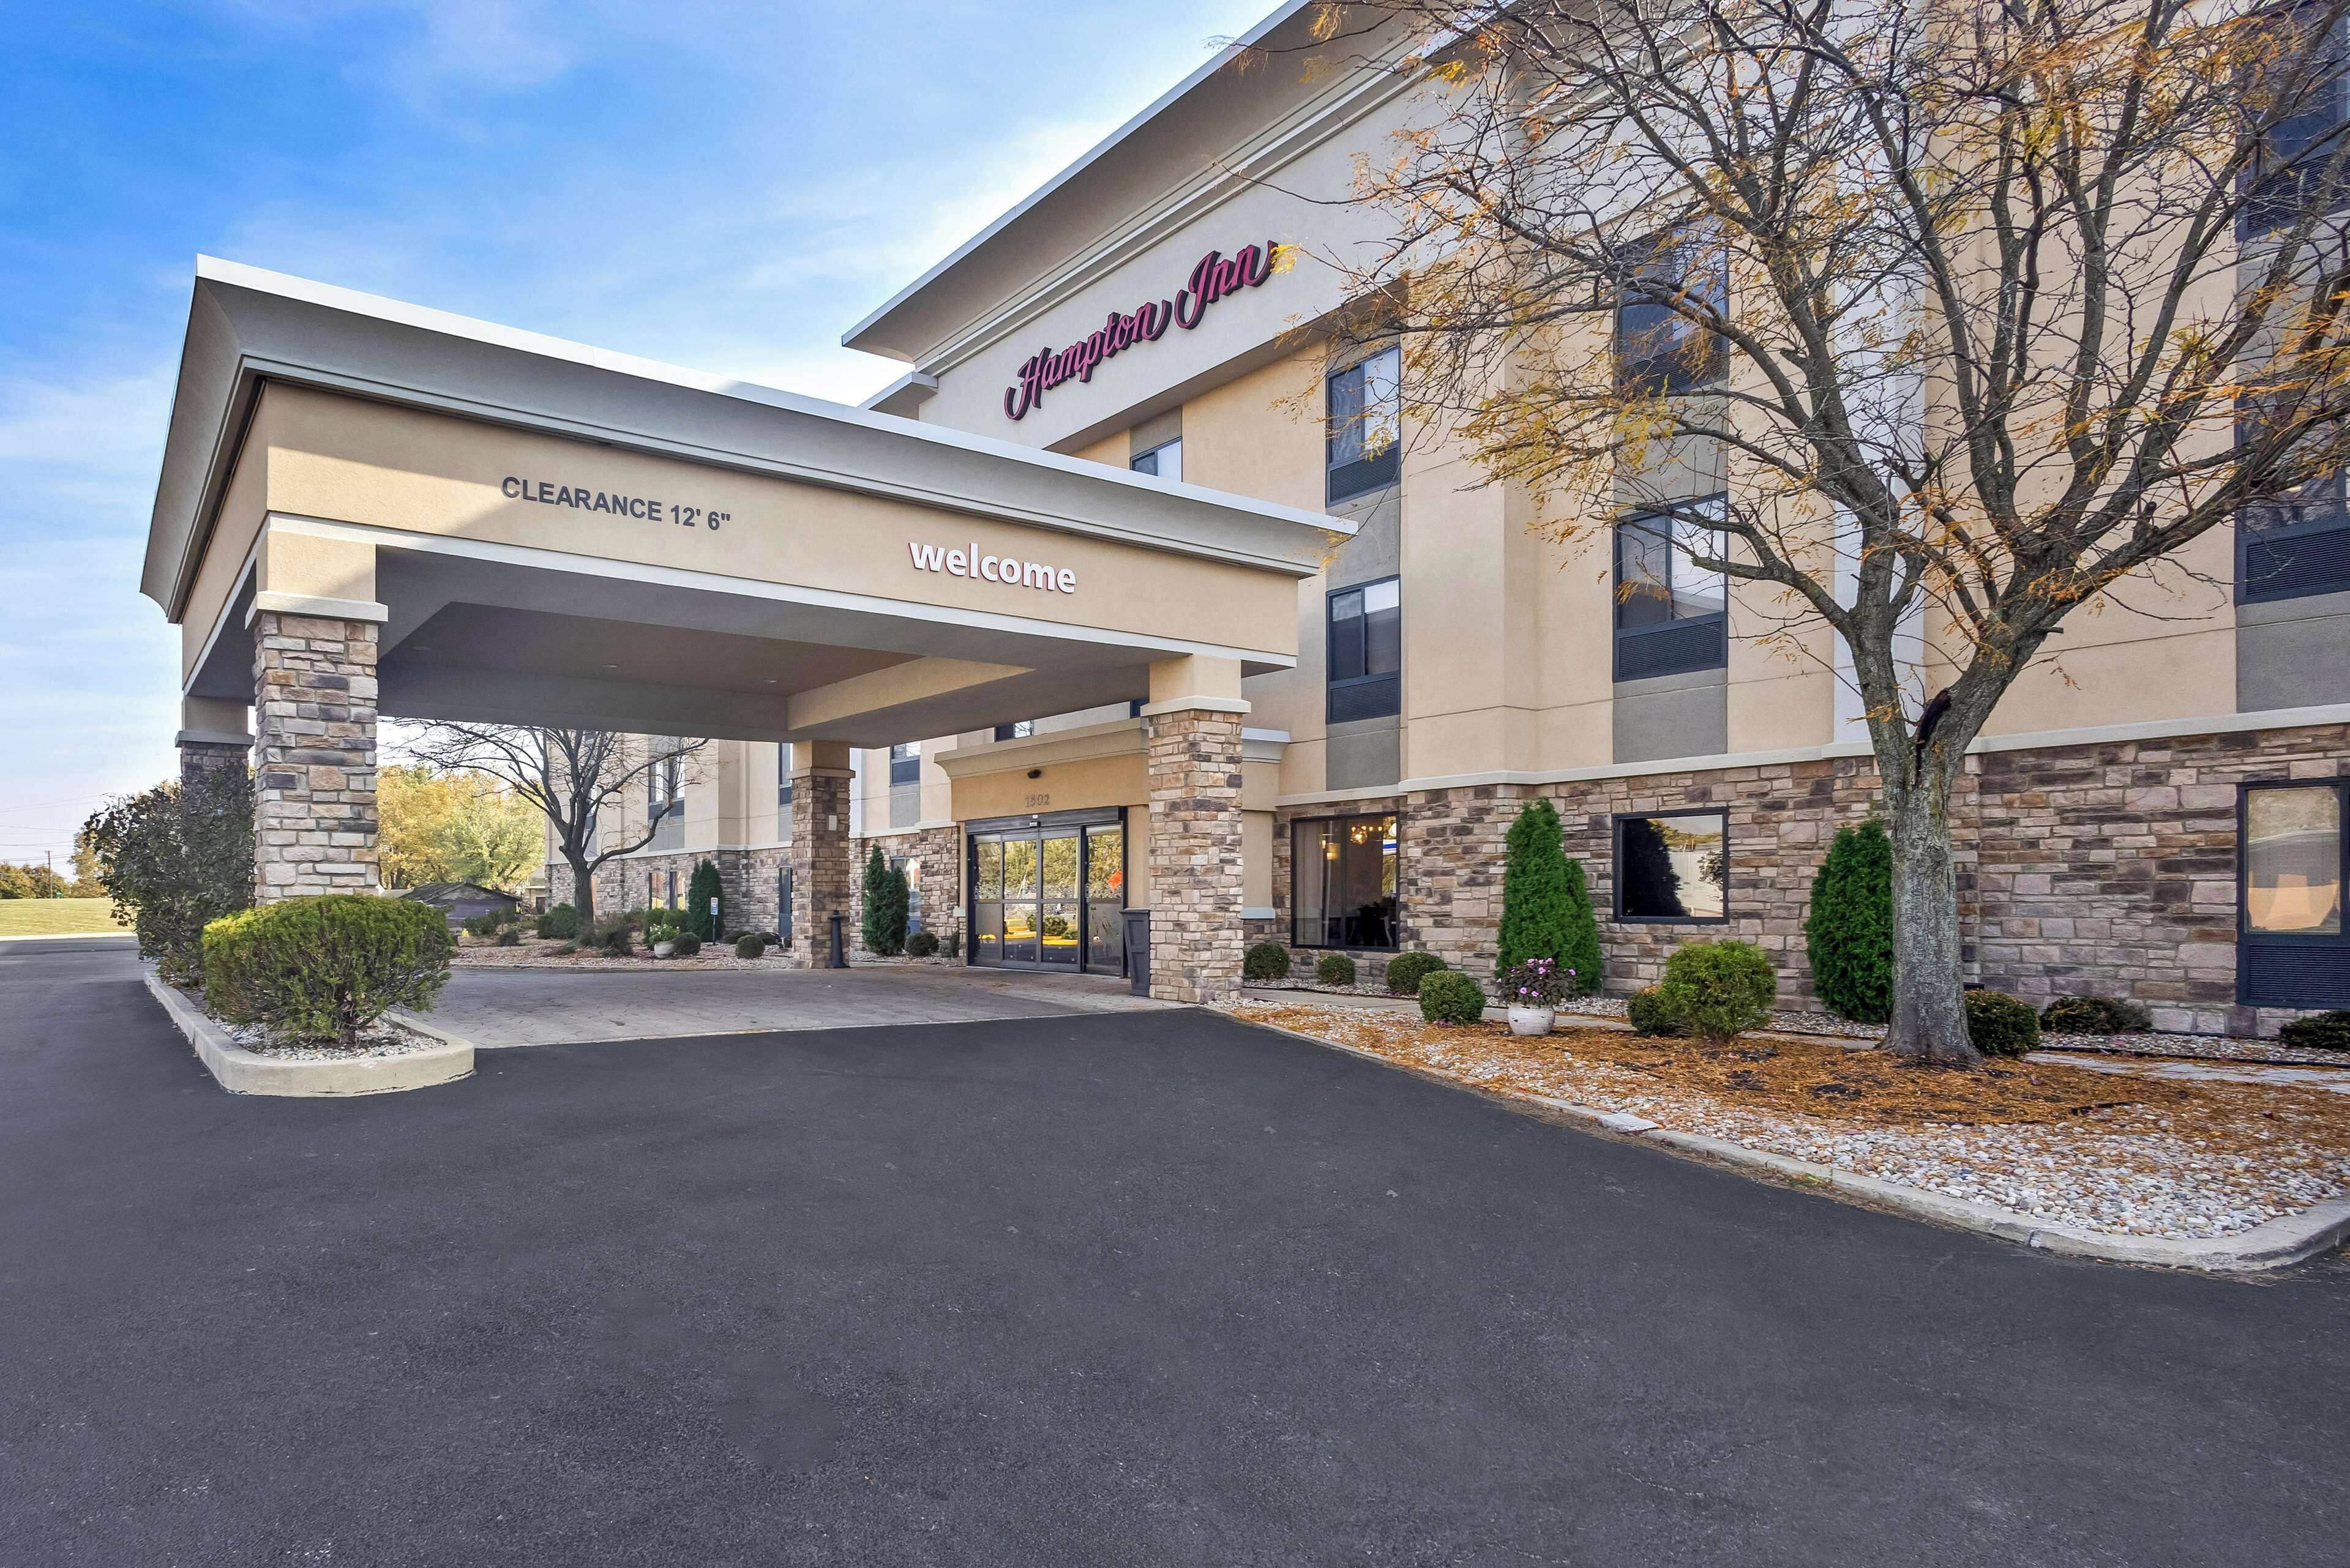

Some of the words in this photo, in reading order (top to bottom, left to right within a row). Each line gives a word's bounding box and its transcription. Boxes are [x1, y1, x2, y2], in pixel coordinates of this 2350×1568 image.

[1004, 299, 1172, 420] Hampton
[1175, 240, 1279, 330] Inn
[502, 476, 662, 521] CLEARANCE
[671, 505, 701, 527] 12'
[708, 511, 730, 531] 6"
[908, 542, 1076, 594] welcome
